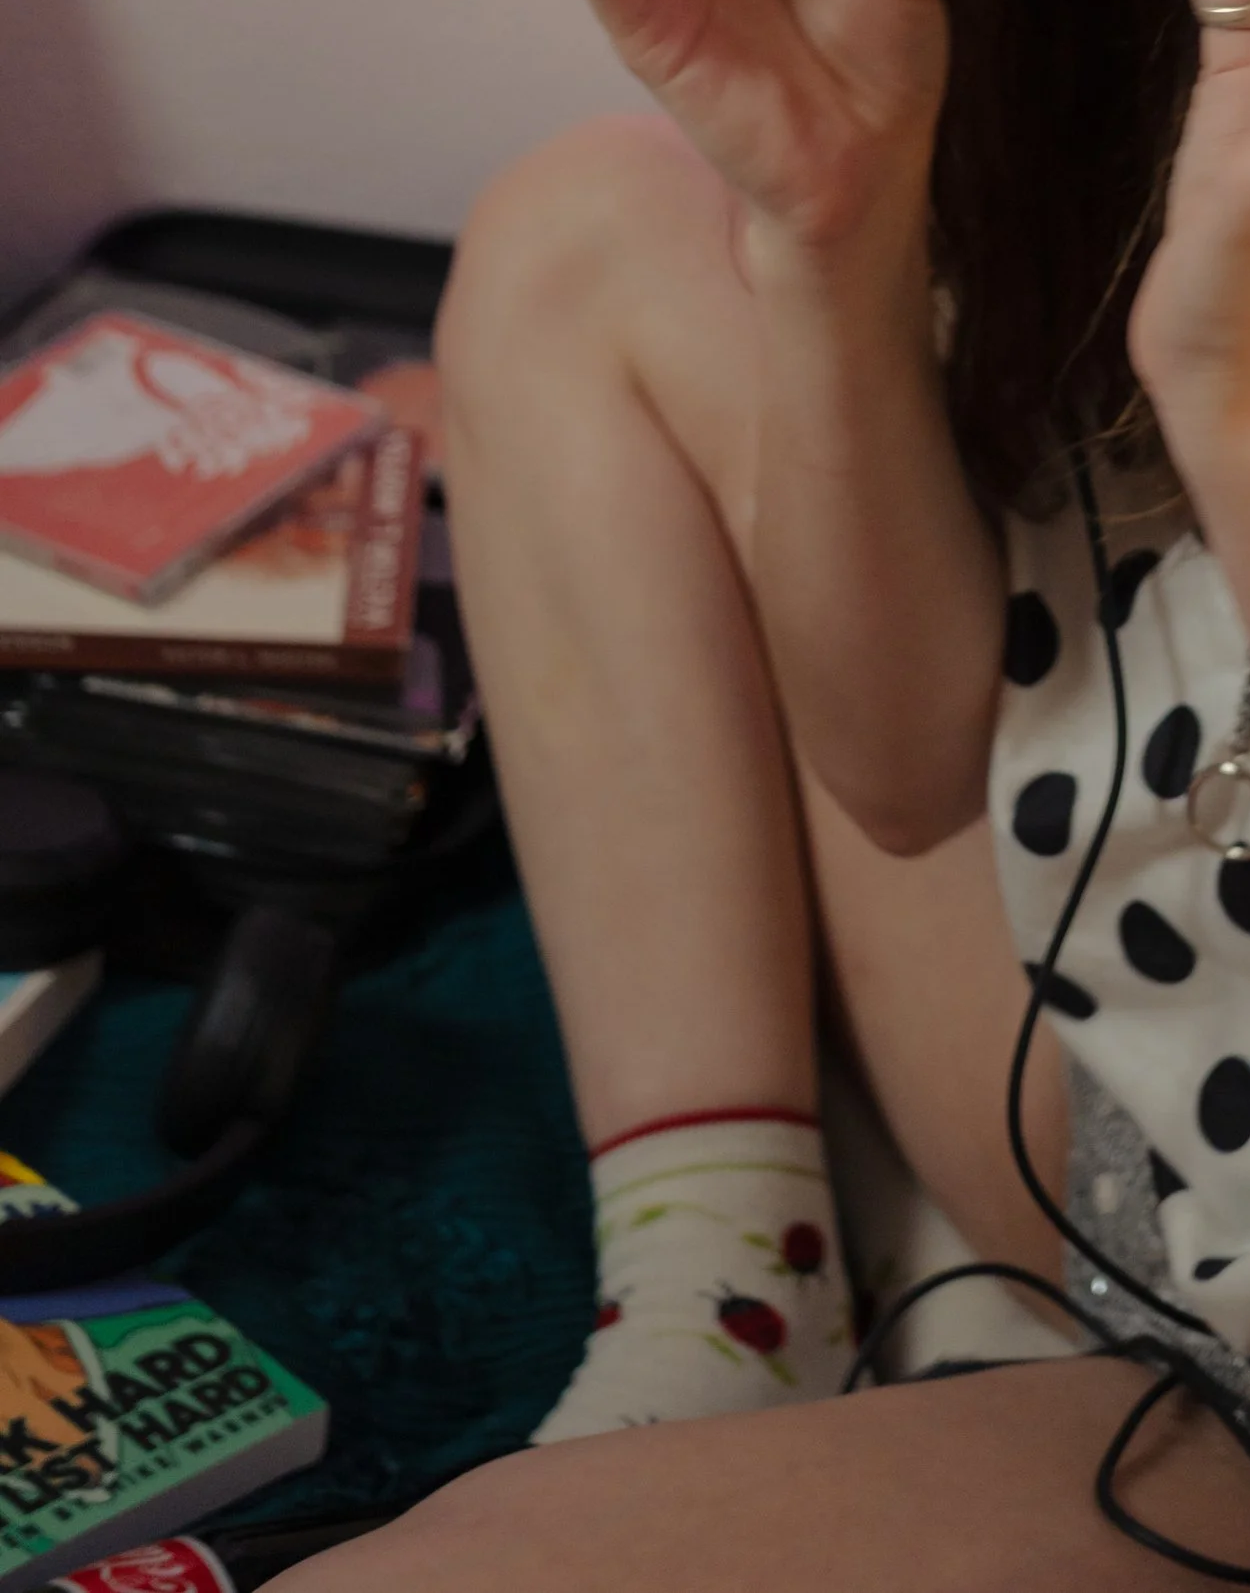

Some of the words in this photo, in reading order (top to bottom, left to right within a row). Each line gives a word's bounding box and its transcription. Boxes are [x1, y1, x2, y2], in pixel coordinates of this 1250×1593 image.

[0, 1417, 60, 1474] K
[52, 1333, 231, 1433] HARD
[0, 1436, 118, 1531] LIST
[119, 1367, 270, 1451] HARD
